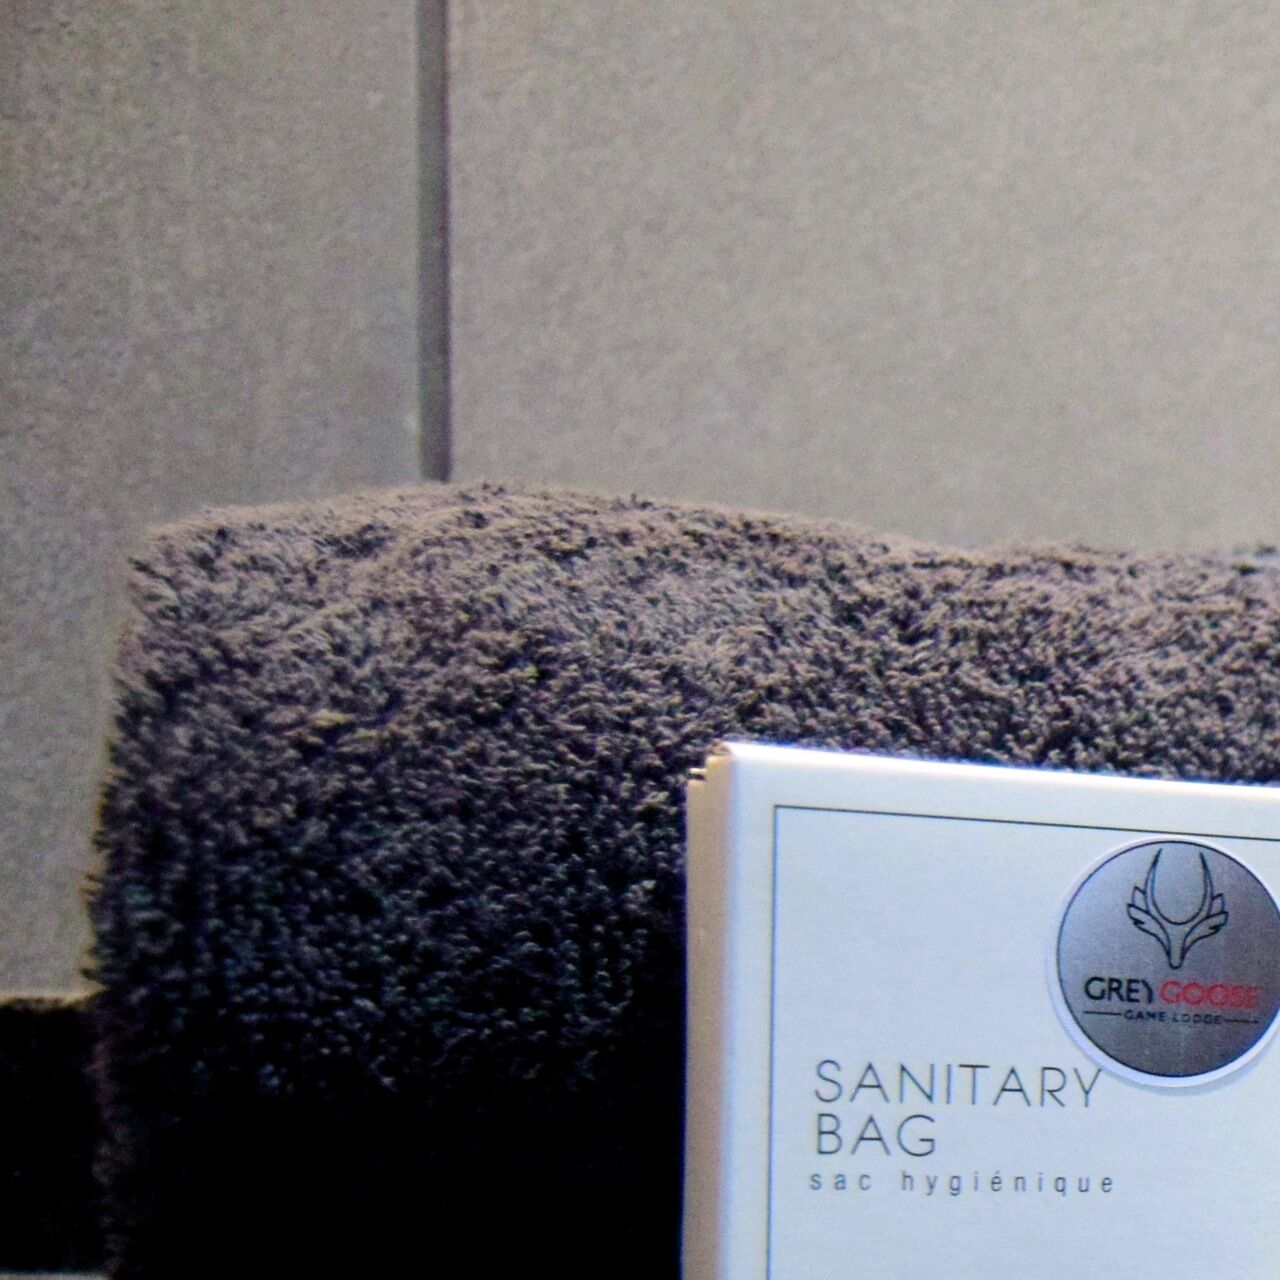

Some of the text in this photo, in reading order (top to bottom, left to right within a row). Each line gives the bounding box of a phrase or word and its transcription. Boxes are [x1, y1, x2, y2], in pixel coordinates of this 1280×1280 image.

[1084, 976, 1260, 1009] GREY GOOSE
[1124, 1009, 1222, 1026] GAME LODGE
[814, 1059, 1102, 1108] SANITARY
[816, 1113, 937, 1157] BAG
[809, 1170, 1114, 1197] sac hygiénique
